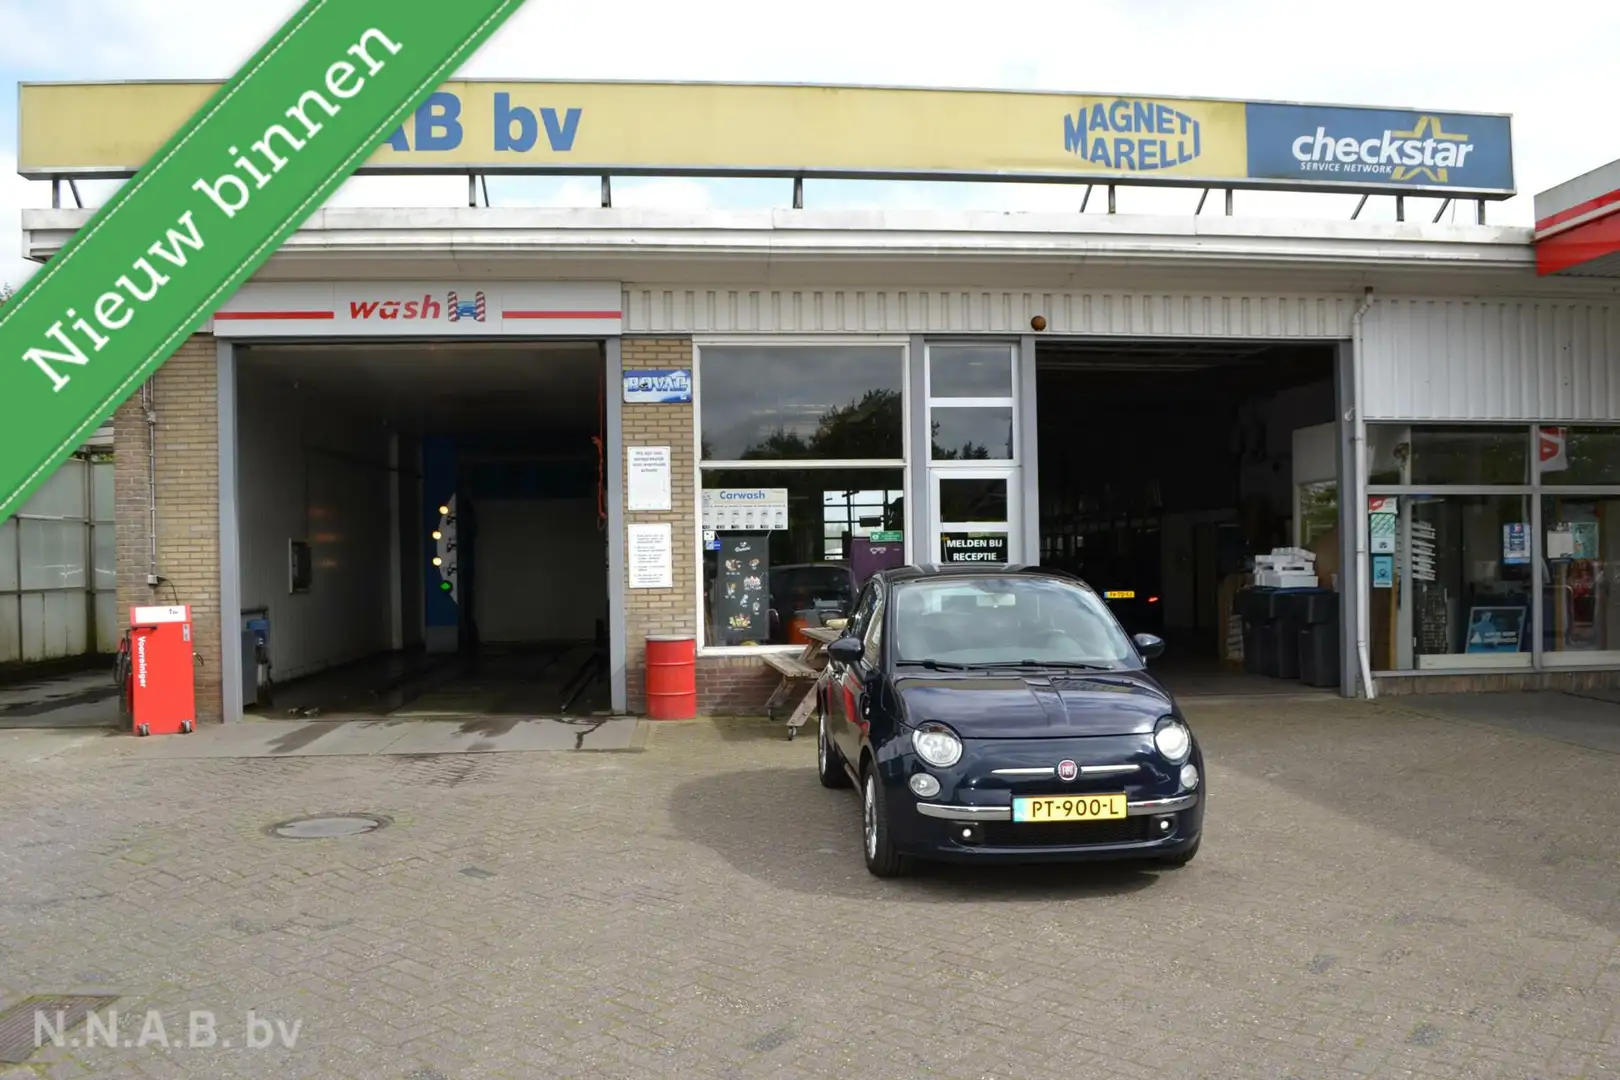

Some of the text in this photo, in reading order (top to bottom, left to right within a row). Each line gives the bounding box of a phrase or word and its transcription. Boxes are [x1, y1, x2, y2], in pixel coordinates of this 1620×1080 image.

[494, 92, 582, 152] bv
[1064, 99, 1201, 146] MAGNETI
[1064, 130, 1201, 171] MARELLI
[1291, 126, 1474, 168] checkstar
[1300, 161, 1392, 174] SERVICE NETWORK
[350, 294, 441, 320] wash
[719, 490, 766, 500] Carwash
[946, 539, 1003, 547] MELDEN BIJ
[953, 552, 997, 560] RECEPTIE
[138, 636, 148, 688] Voorreiniger
[1032, 798, 1119, 818] PT-900-L
